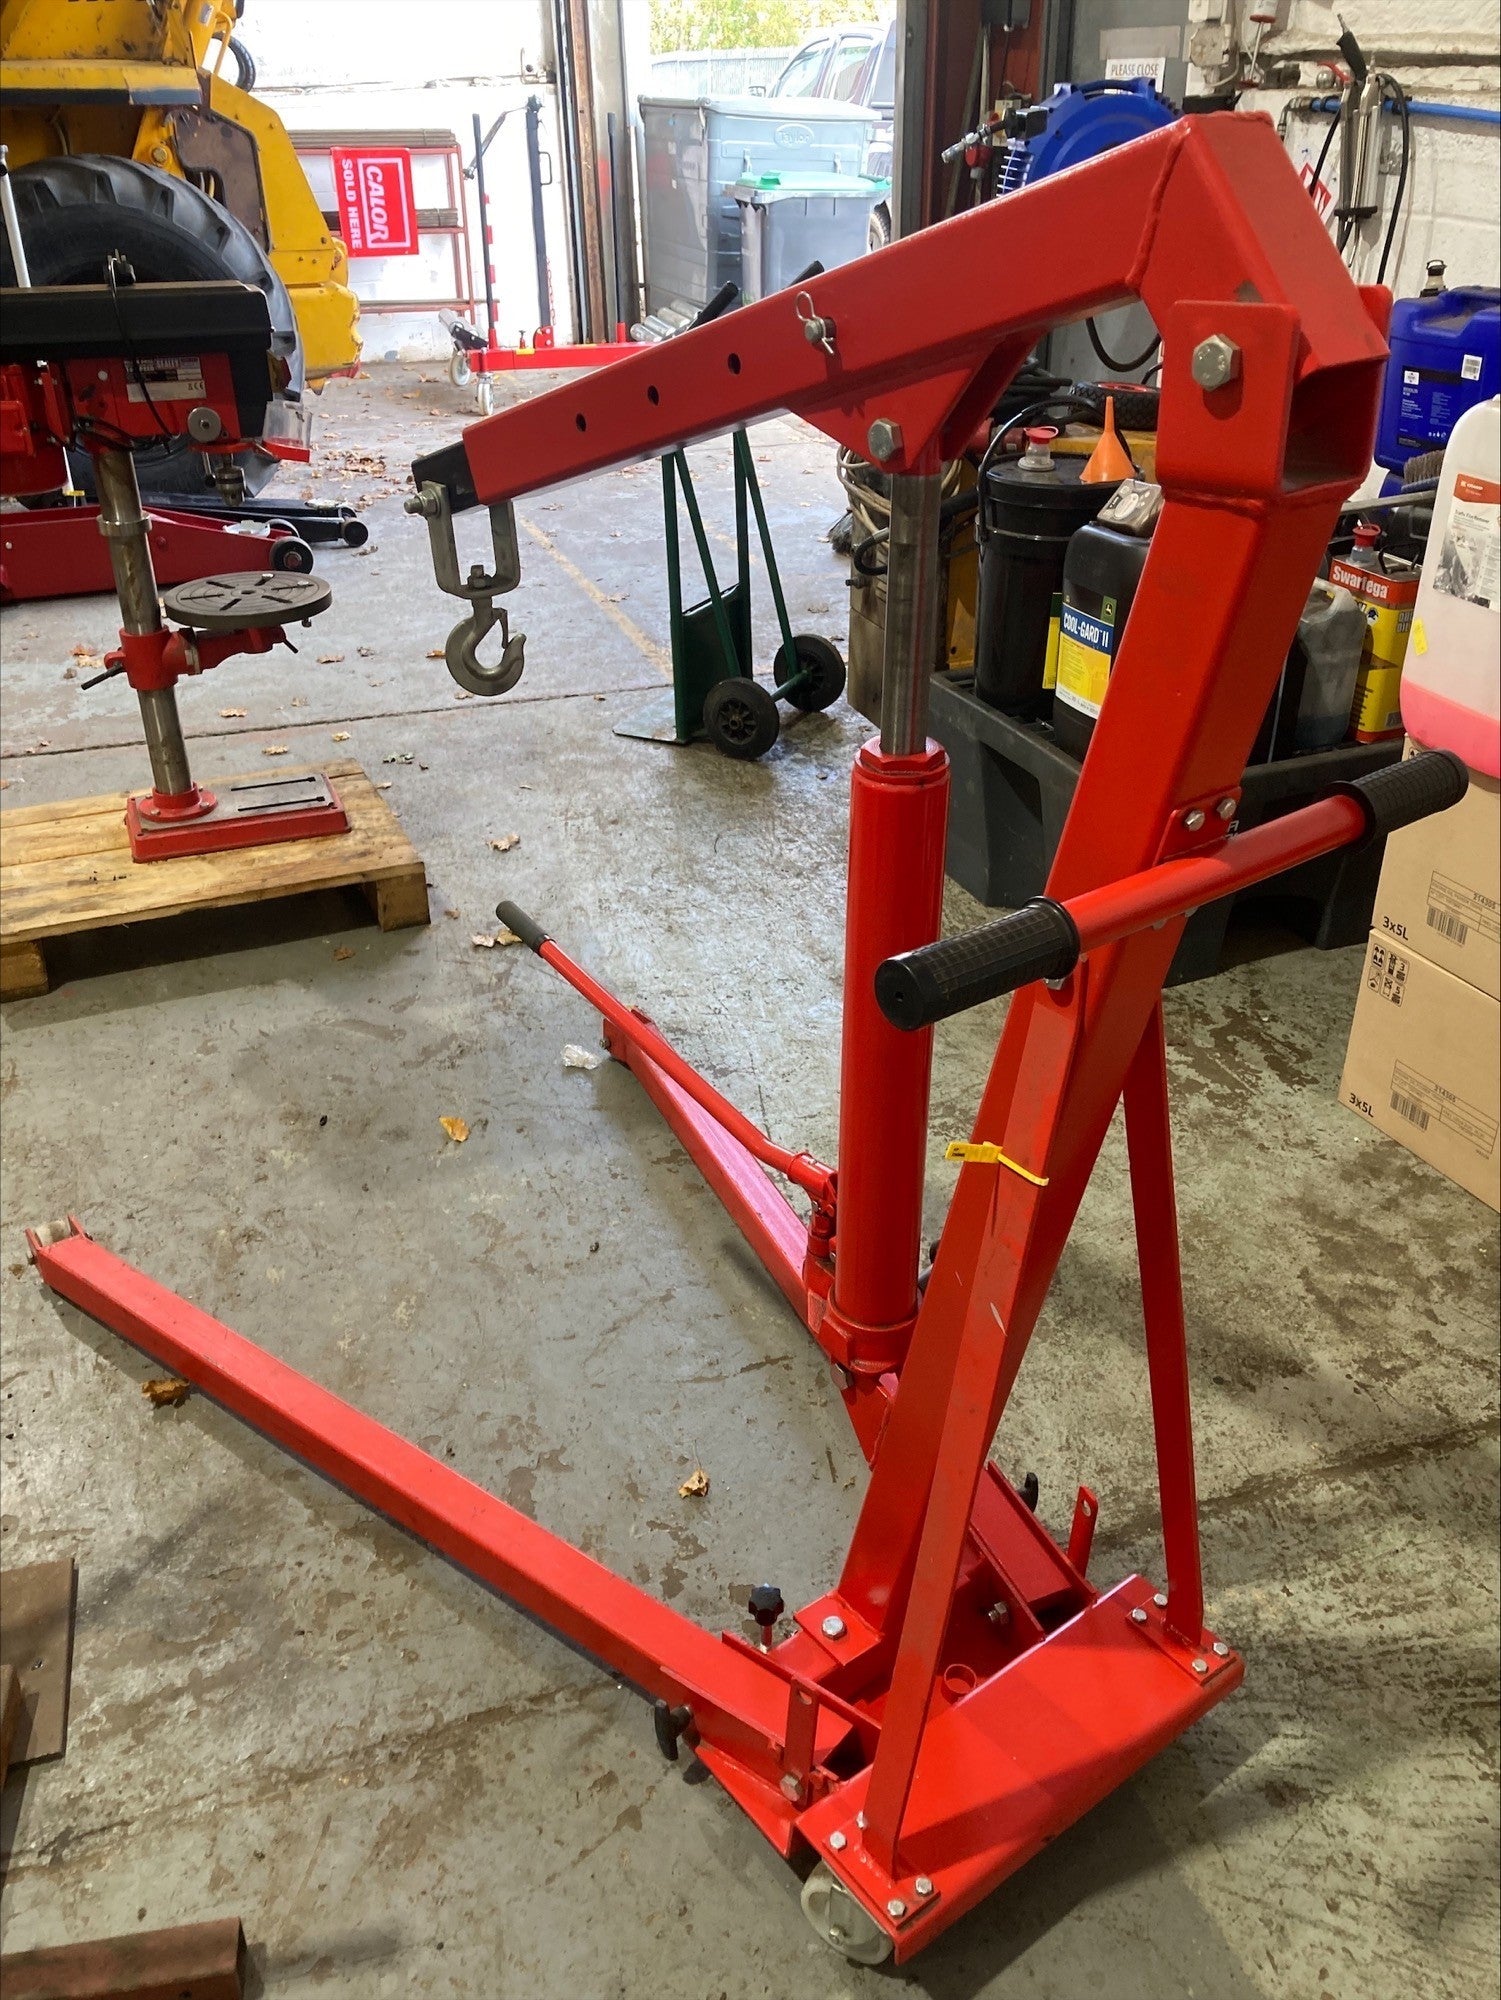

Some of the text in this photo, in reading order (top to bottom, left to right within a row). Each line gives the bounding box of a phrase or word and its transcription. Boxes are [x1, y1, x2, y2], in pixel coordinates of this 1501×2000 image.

[1111, 63, 1159, 77] PLEASE CLOSE
[342, 158, 363, 250] SOLD HERE
[366, 165, 390, 242] CALOR
[1382, 916, 1409, 941] 3x5L
[1349, 1092, 1375, 1118] 3x5L
